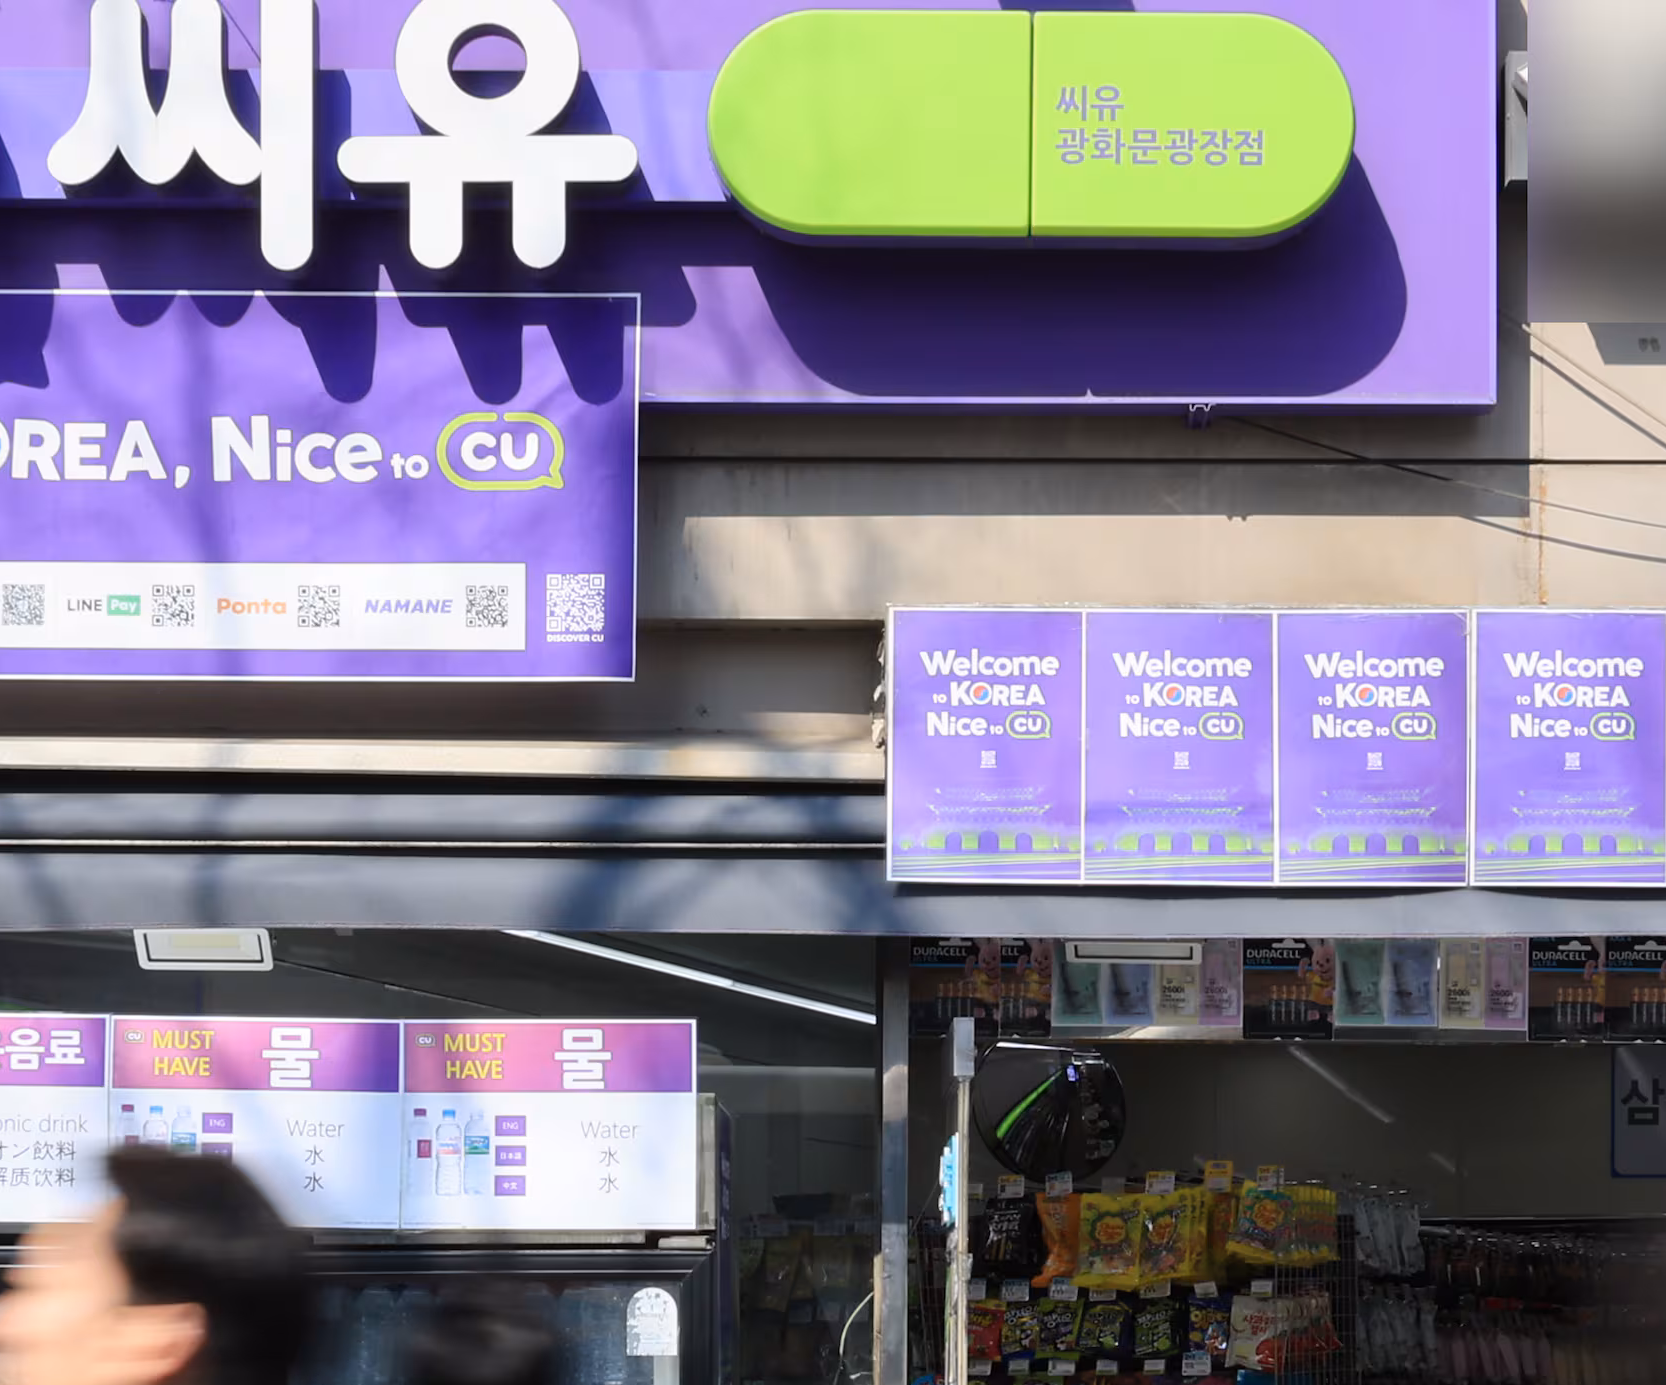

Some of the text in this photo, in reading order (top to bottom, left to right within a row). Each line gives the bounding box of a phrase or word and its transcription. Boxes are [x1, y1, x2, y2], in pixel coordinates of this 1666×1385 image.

[1055, 85, 1124, 121] 씨유
[47, 0, 638, 270] 씨유
[1055, 127, 1264, 166] 광화문광장점
[211, 415, 383, 483] Nice
[390, 452, 429, 480] to
[460, 431, 539, 472] CU
[66, 597, 139, 614] LINE Pay
[217, 597, 287, 615] Ponta
[364, 598, 452, 614] NAMANE
[546, 633, 589, 643] DISCOVER
[919, 648, 1060, 677] Welcome
[1112, 649, 1253, 678] Welcome
[1304, 650, 1445, 679] Welcome
[1503, 650, 1644, 679] Welcome
[950, 681, 1046, 706] KOREA
[1126, 682, 1239, 707] to KOREA
[1318, 683, 1431, 708] to KOREA
[1517, 683, 1630, 708] to KOREA
[927, 711, 988, 736] Nice
[1120, 712, 1181, 737] Nice
[1312, 713, 1373, 738] Nice
[1511, 713, 1572, 738] Nice
[913, 946, 967, 957] DURACELL
[1246, 948, 1302, 961] DURACELL
[1532, 951, 1588, 963] DURACELL
[1609, 949, 1663, 962] DURACELL
[152, 1030, 214, 1049] MUST
[444, 1033, 506, 1053] MUST
[154, 1057, 211, 1076] HAVE
[262, 1027, 321, 1088] 물
[554, 1027, 613, 1090] 물
[446, 1060, 503, 1079] HAVE
[38, 1113, 89, 1133] drink
[286, 1119, 345, 1138] Water
[581, 1121, 638, 1140] Water
[305, 1145, 325, 1166] 水
[599, 1147, 620, 1167] 水
[303, 1172, 324, 1192] 水
[599, 1173, 620, 1194] 水
